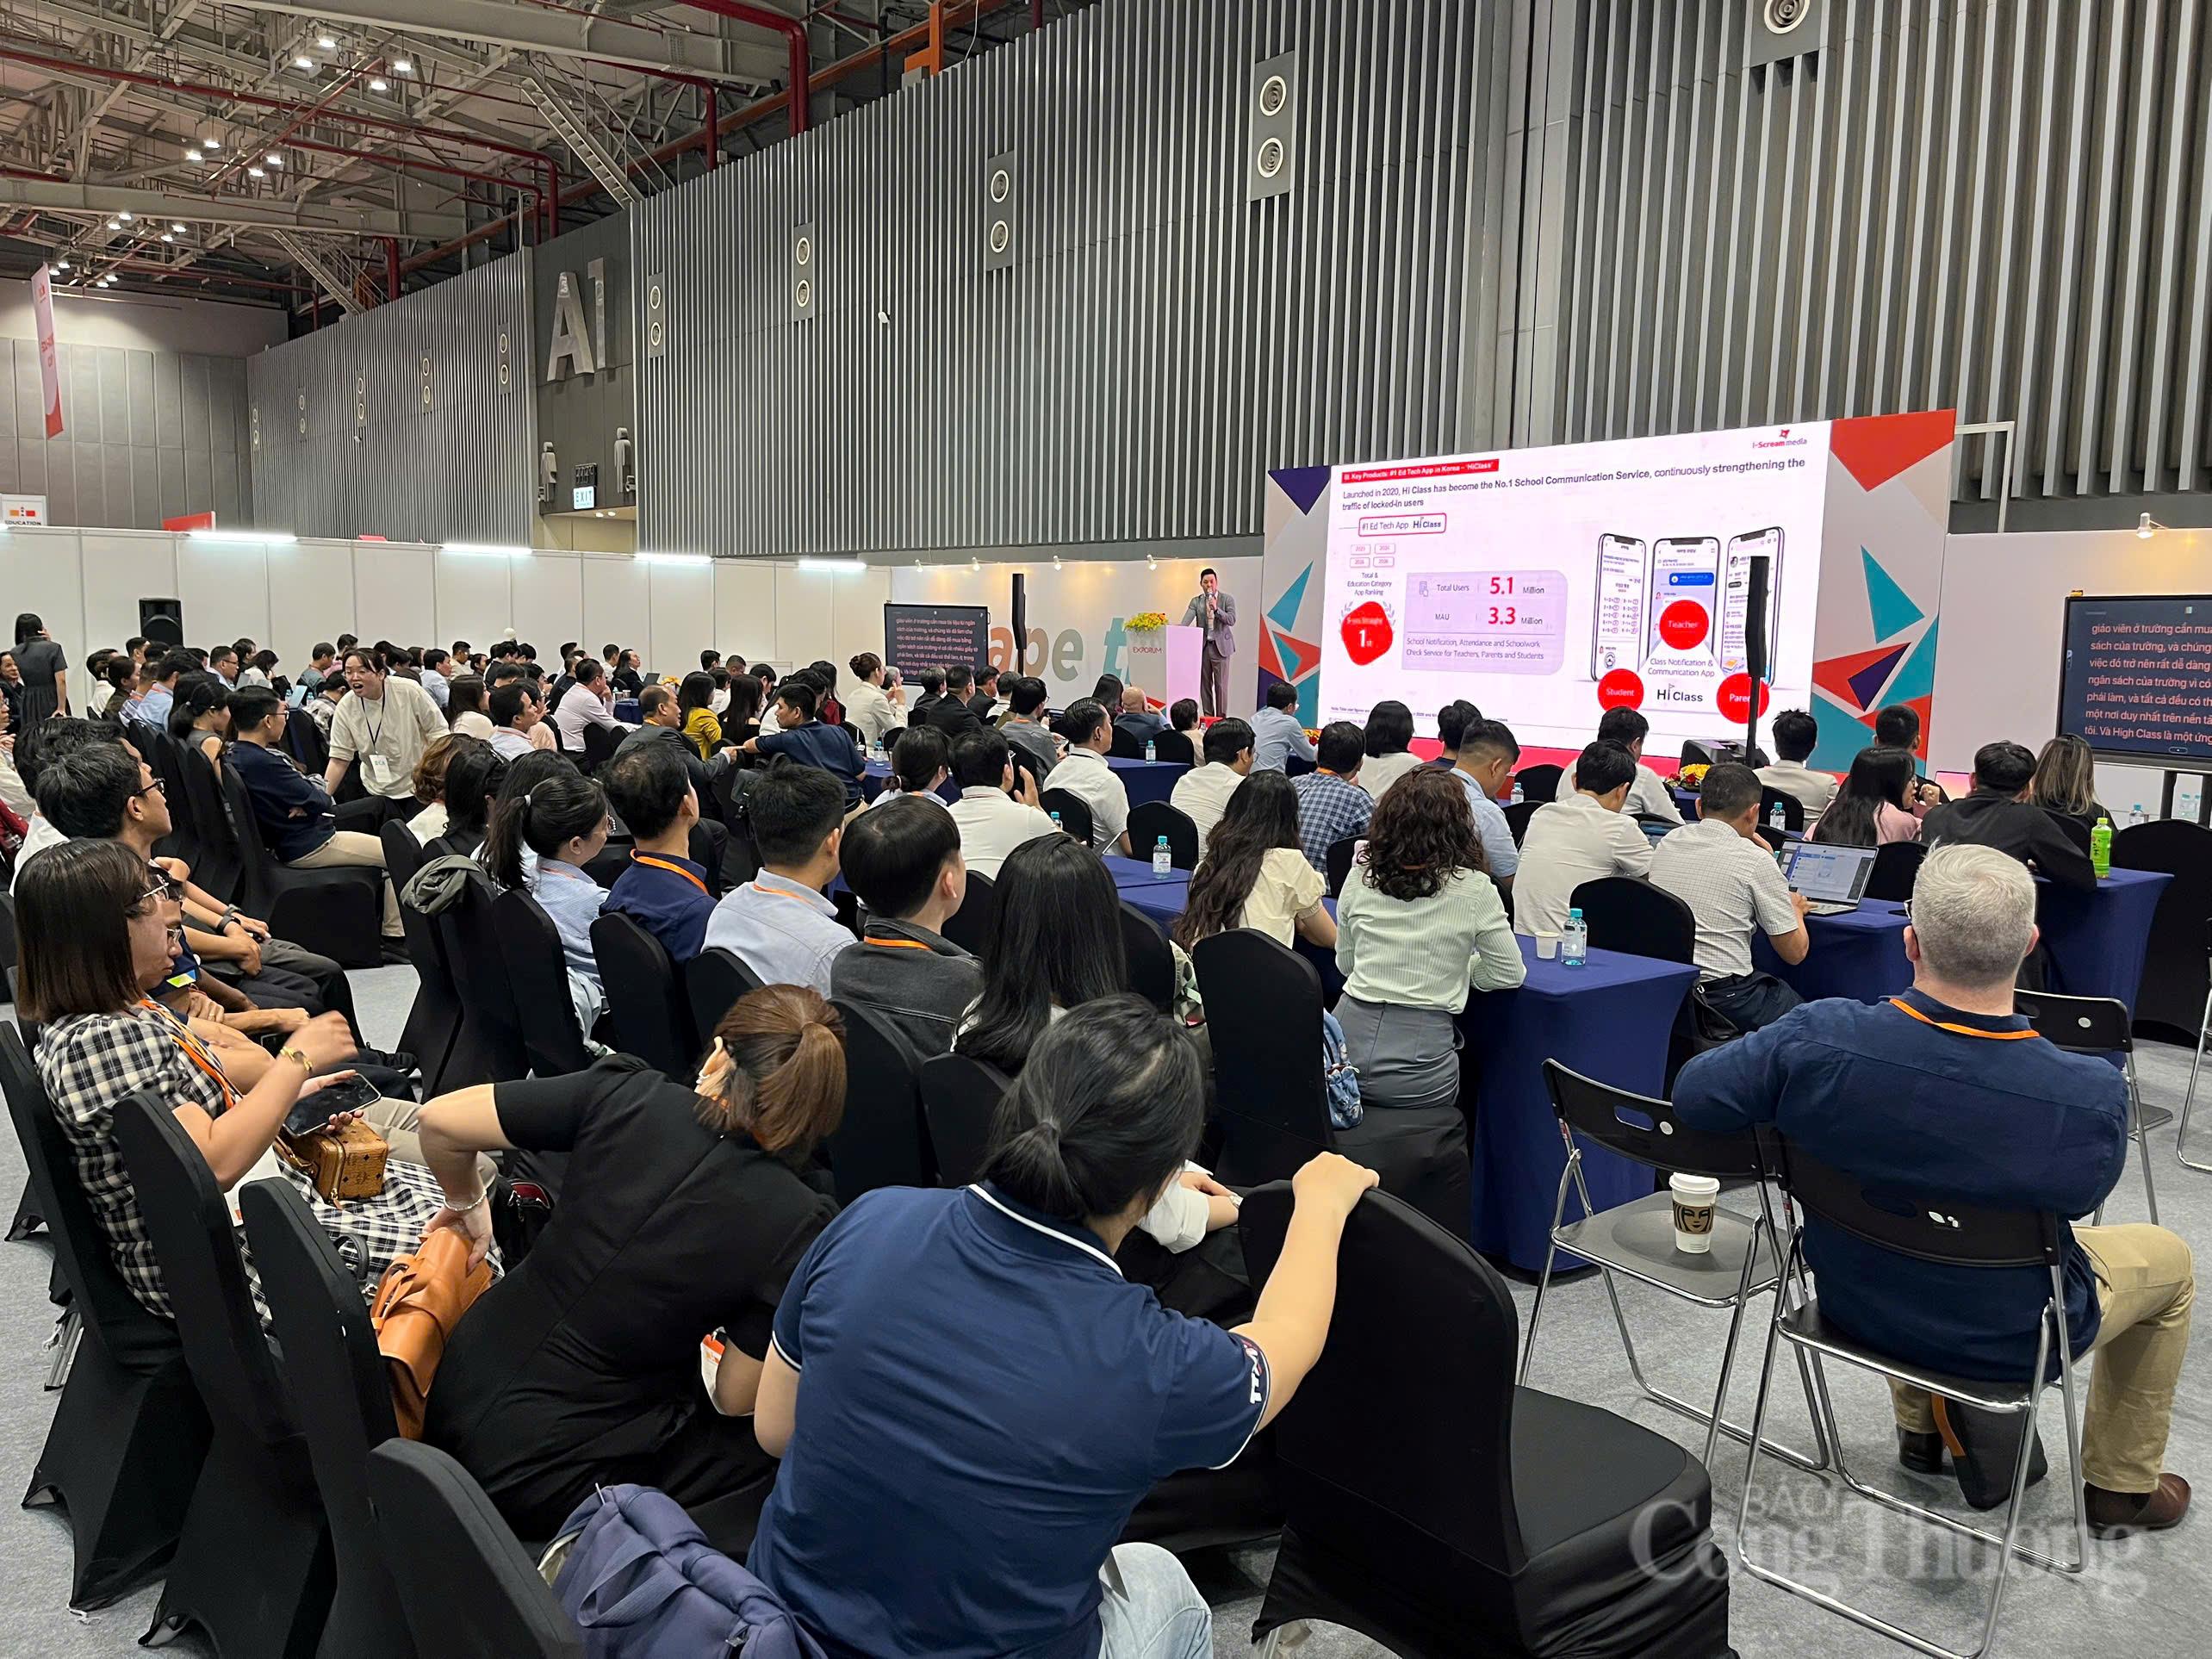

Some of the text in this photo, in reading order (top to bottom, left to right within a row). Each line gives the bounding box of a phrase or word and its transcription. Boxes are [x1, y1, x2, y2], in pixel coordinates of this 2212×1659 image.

[546, 258, 606, 382] A1
[1343, 489, 1374, 499] Launched
[1382, 488, 1401, 497] 2020,
[1412, 486, 1432, 494] Class
[1433, 484, 1447, 493] has
[1449, 483, 1479, 492] become
[1481, 481, 1493, 489] the
[1494, 480, 1513, 488] No.1
[1514, 477, 1544, 488] School
[1545, 473, 1613, 485] Communication
[1616, 469, 1652, 480] Service,
[1654, 463, 1711, 478] continuously
[1712, 460, 1785, 474] strengthening
[1787, 458, 1805, 468] the
[575, 490, 593, 503] EXIT
[1343, 502, 1361, 511] traffic
[1363, 500, 1370, 509] of
[1371, 500, 1401, 509] locked-in
[1395, 521, 1409, 531] App
[1413, 519, 1422, 529] Hi
[1489, 576, 1513, 594] 5.1
[1488, 606, 1516, 624] 3.3
[2091, 623, 2111, 635] giáo
[2113, 623, 2131, 633] viên
[2141, 624, 2173, 636] trường
[1426, 638, 1457, 647] Notification,
[2091, 640, 2212, 655] sách của trường, và chúng
[1482, 650, 1503, 659] Parents
[1517, 651, 1544, 660] Students
[2090, 657, 2211, 672] việc đó trở nên rất dễ dàng
[1647, 668, 1715, 678] Communication App
[2088, 675, 2211, 689] ngân sách của trường vì có
[1606, 688, 1635, 697] Student
[1656, 687, 1703, 702] Hi Class
[1729, 693, 1750, 703] Pare
[2087, 693, 2106, 703] phải
[2108, 693, 2126, 704] làm,
[2128, 693, 2139, 703] và
[2141, 693, 2153, 704] tất
[2155, 694, 2166, 705] cả
[2189, 696, 2201, 706] có
[2085, 709, 2103, 720] một
[2104, 710, 2119, 719] nơi
[2121, 711, 2138, 723] duy
[2140, 710, 2160, 722] nhất
[2162, 712, 2181, 723] trên
[2085, 724, 2098, 735] tôi.
[2100, 726, 2111, 736] Và
[2113, 727, 2134, 739] High
[2136, 729, 2162, 740] Class
[2164, 730, 2172, 741] là
[2173, 731, 2193, 743] một
